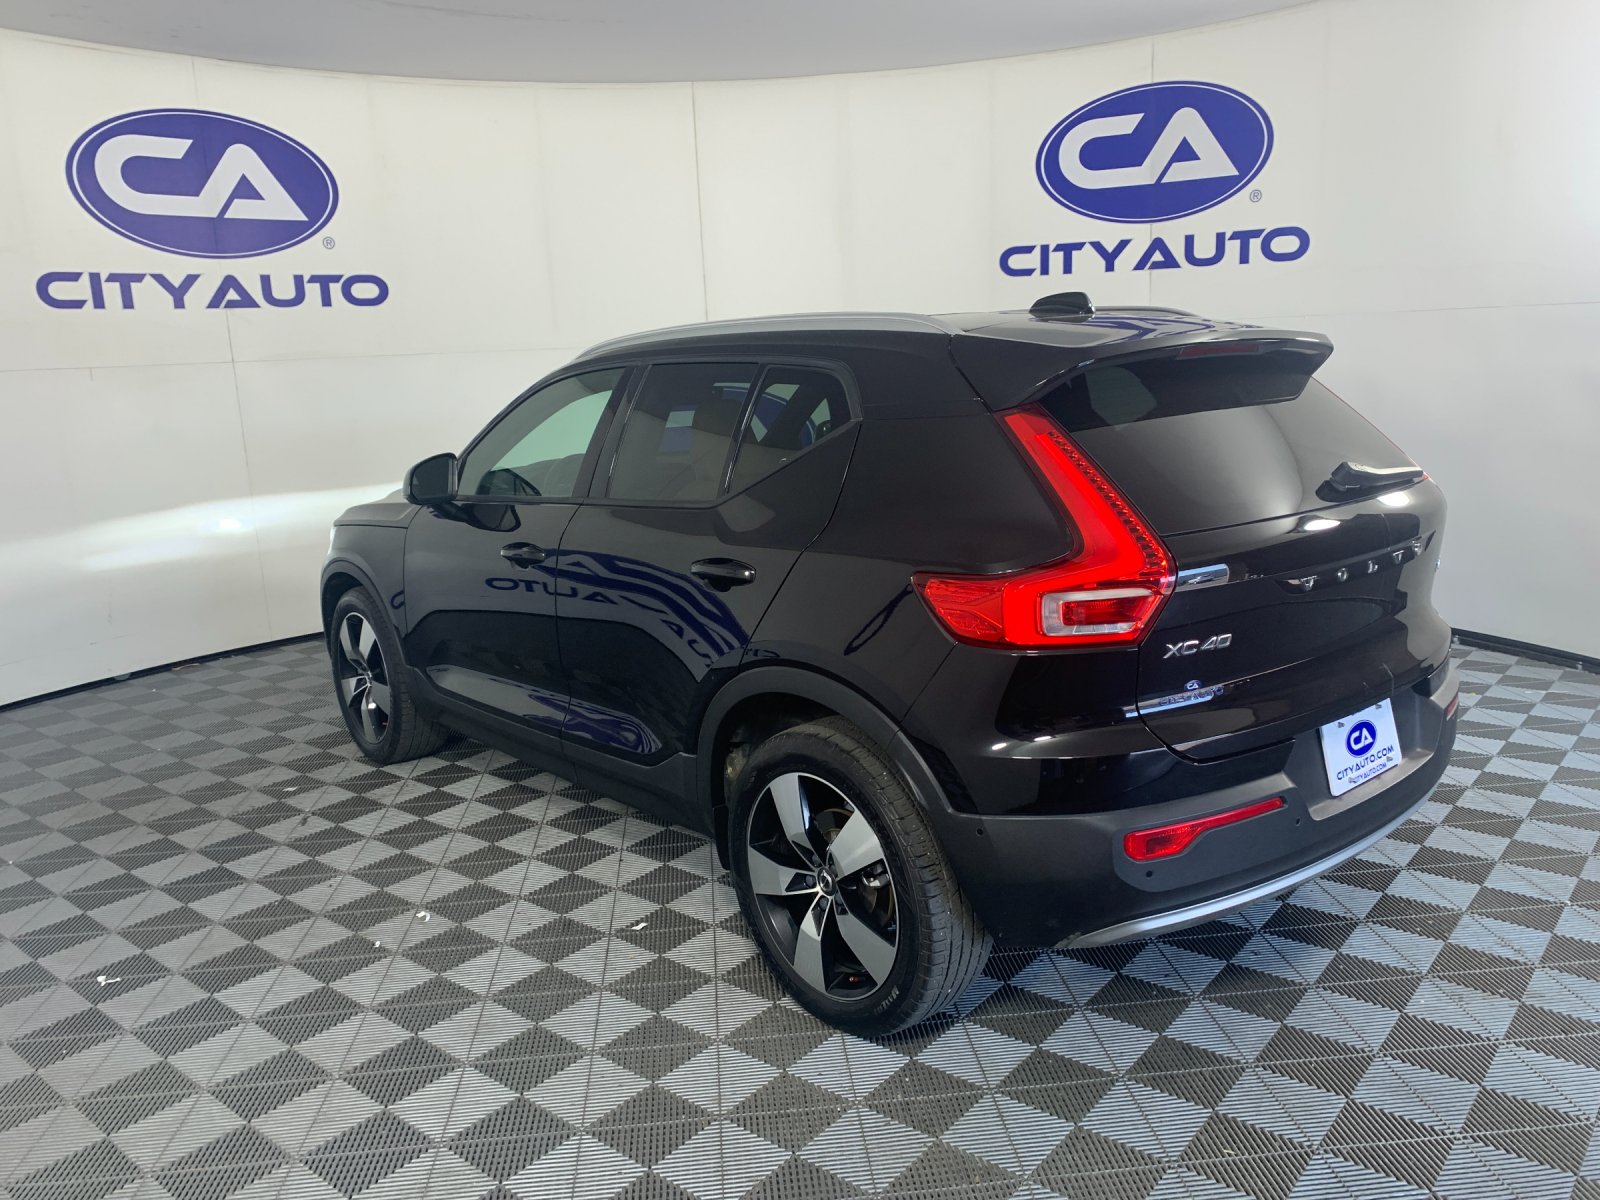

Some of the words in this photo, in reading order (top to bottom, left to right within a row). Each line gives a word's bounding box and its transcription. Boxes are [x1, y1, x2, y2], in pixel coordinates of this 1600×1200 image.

[94, 134, 309, 221] CA
[1058, 106, 1240, 190] CA
[1349, 727, 1374, 751] CA
